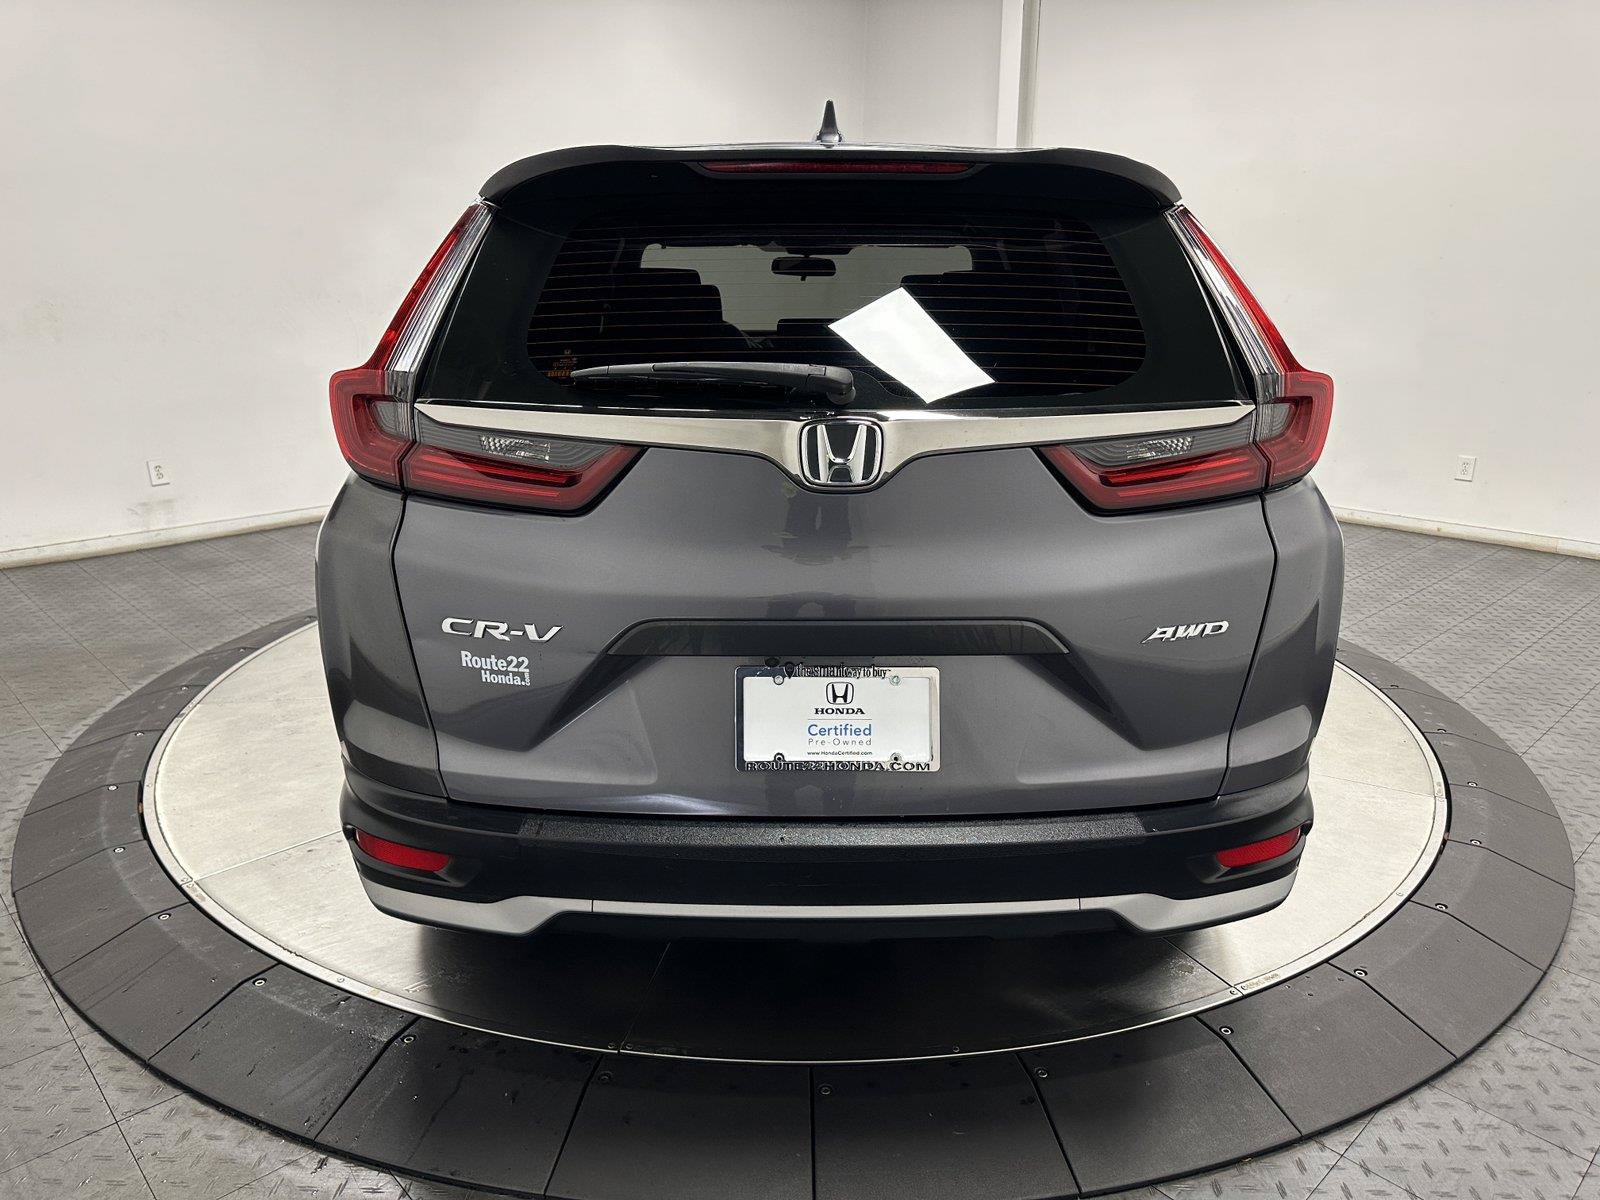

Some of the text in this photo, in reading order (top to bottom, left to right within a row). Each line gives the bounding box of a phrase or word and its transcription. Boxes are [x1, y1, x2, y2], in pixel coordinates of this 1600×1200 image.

[441, 617, 563, 643] CR-V
[1141, 620, 1229, 643] AWD
[460, 650, 530, 673] Route22
[863, 665, 871, 677] to
[814, 707, 866, 715] HONDA
[807, 723, 872, 737] Certified
[808, 738, 872, 746] Pre-Owned
